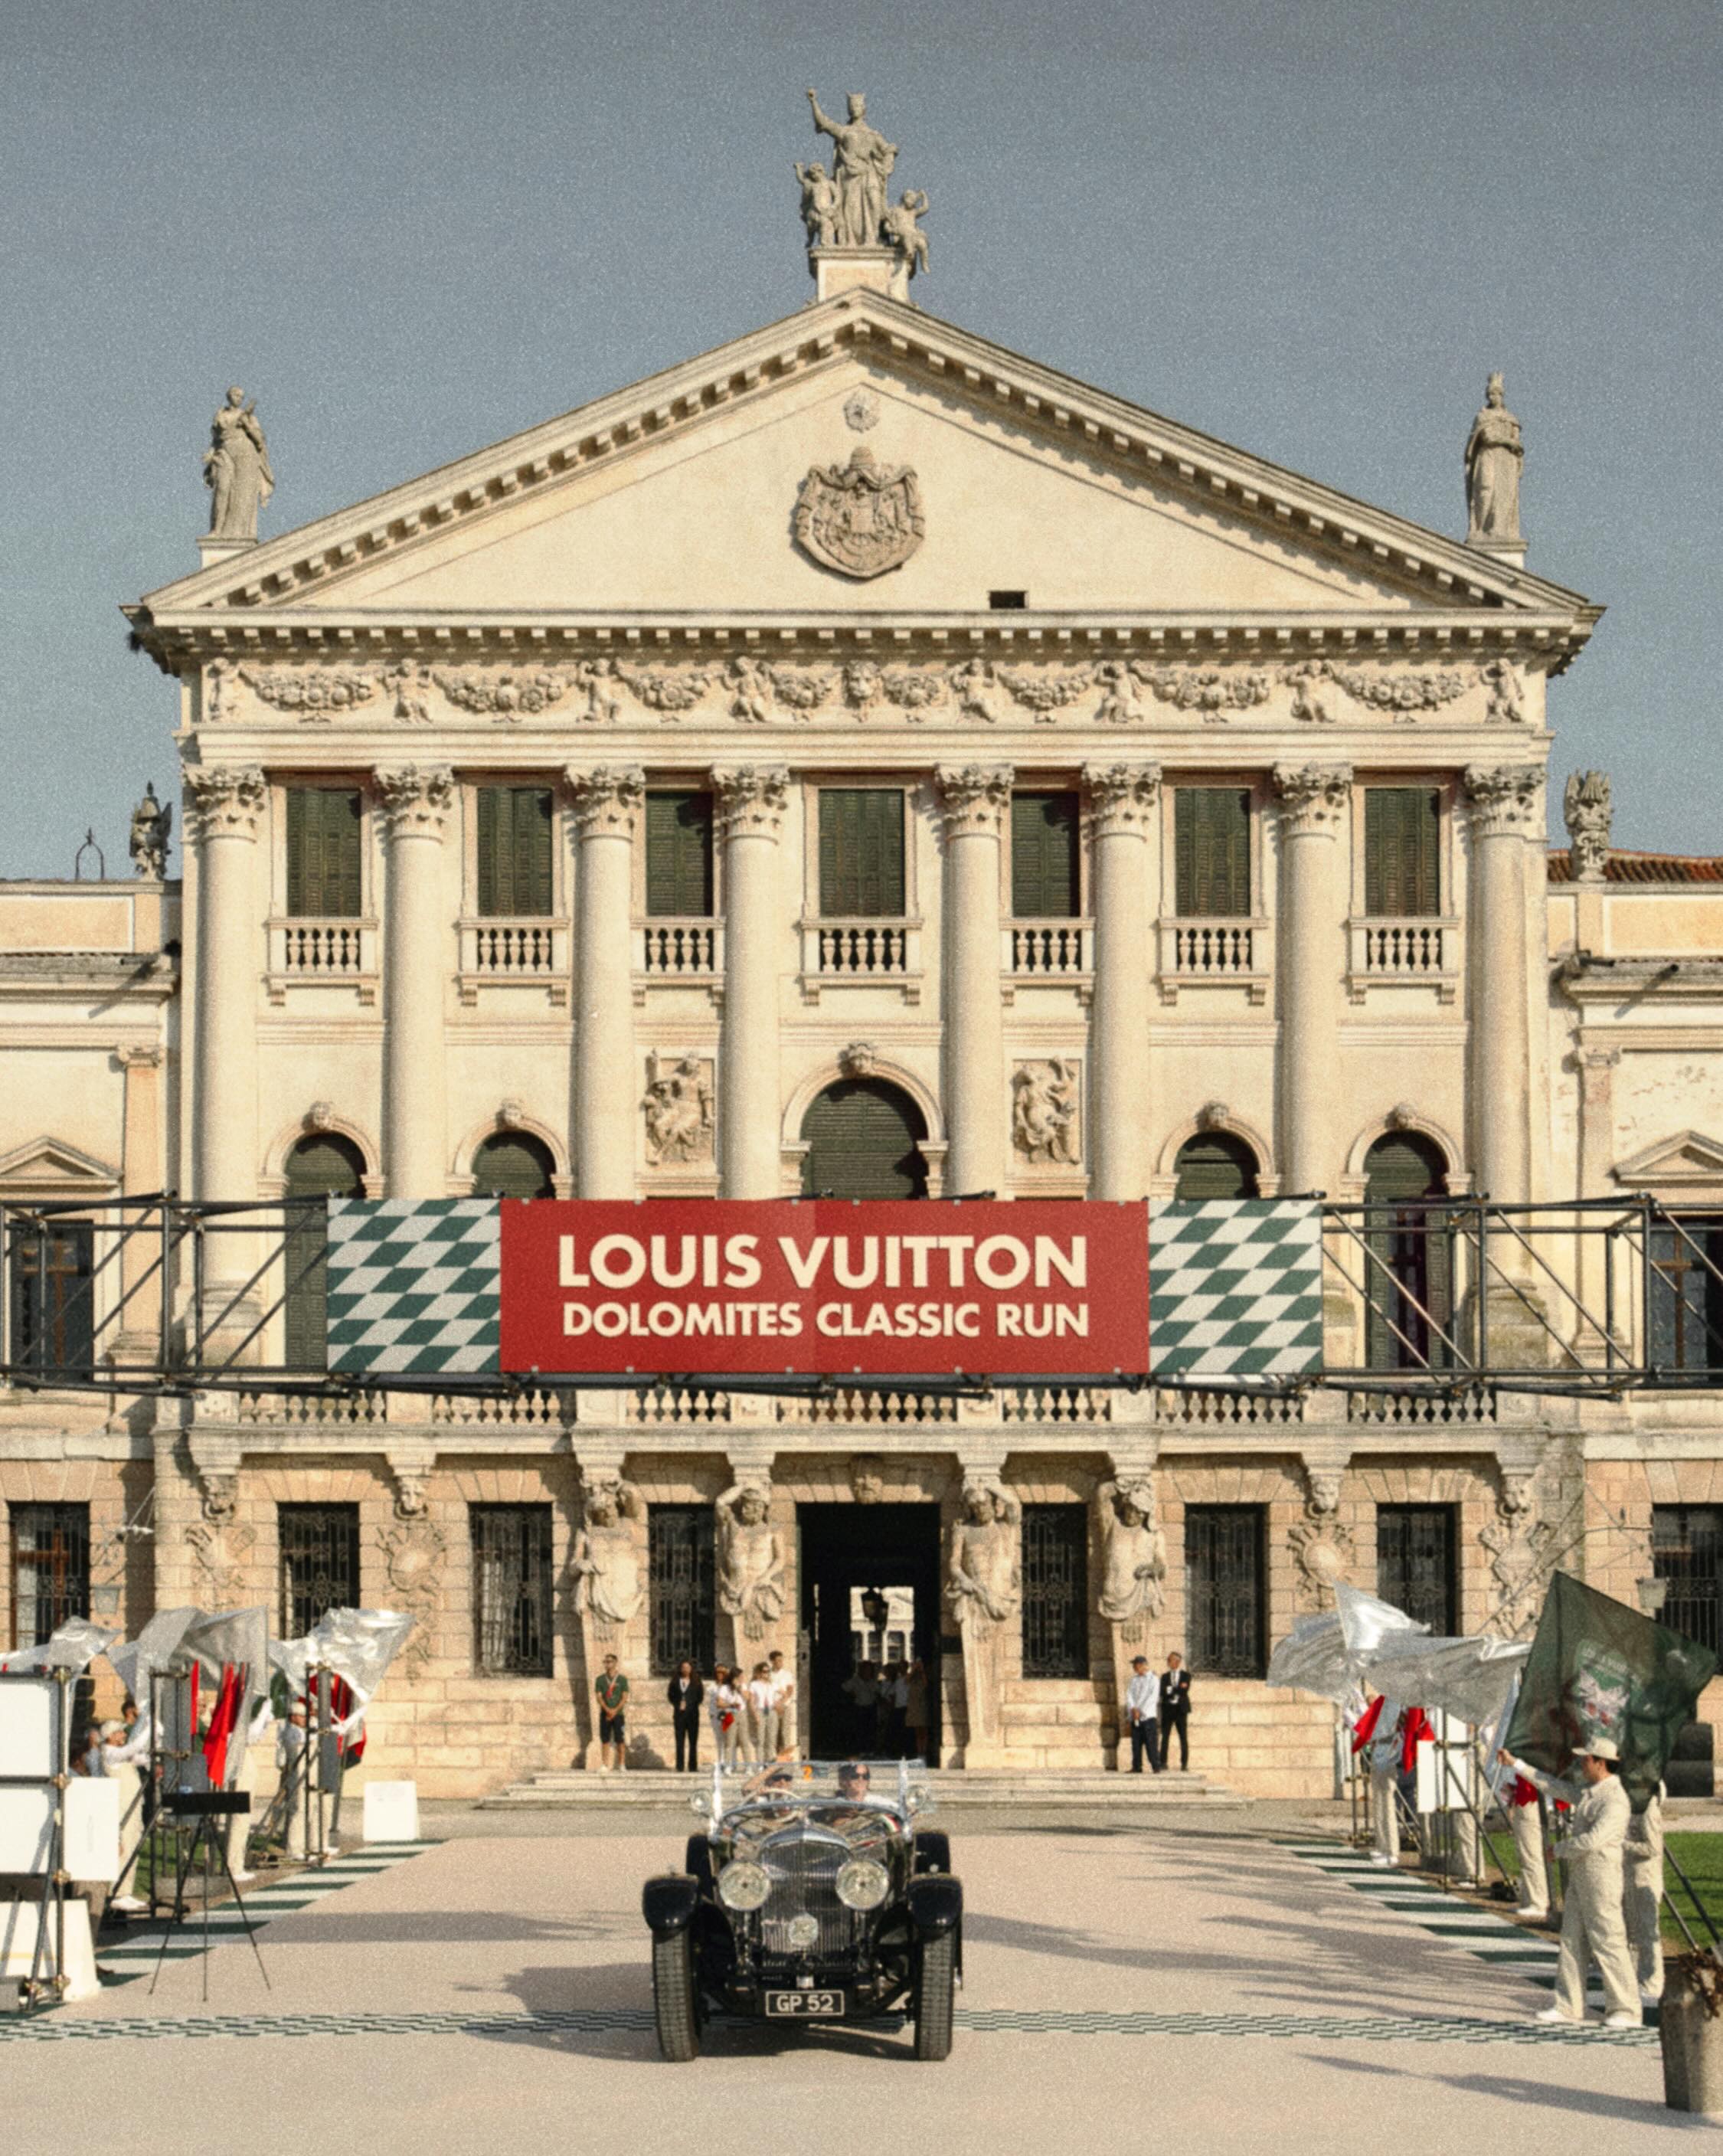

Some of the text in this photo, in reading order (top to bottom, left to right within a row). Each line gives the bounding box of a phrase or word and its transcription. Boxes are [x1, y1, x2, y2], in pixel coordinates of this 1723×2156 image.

[558, 1234, 1087, 1290] LOUIS VUITTON
[563, 1301, 1089, 1338] DOLOMITES CLASSIC RUN
[776, 1994, 834, 2013] GP 52
